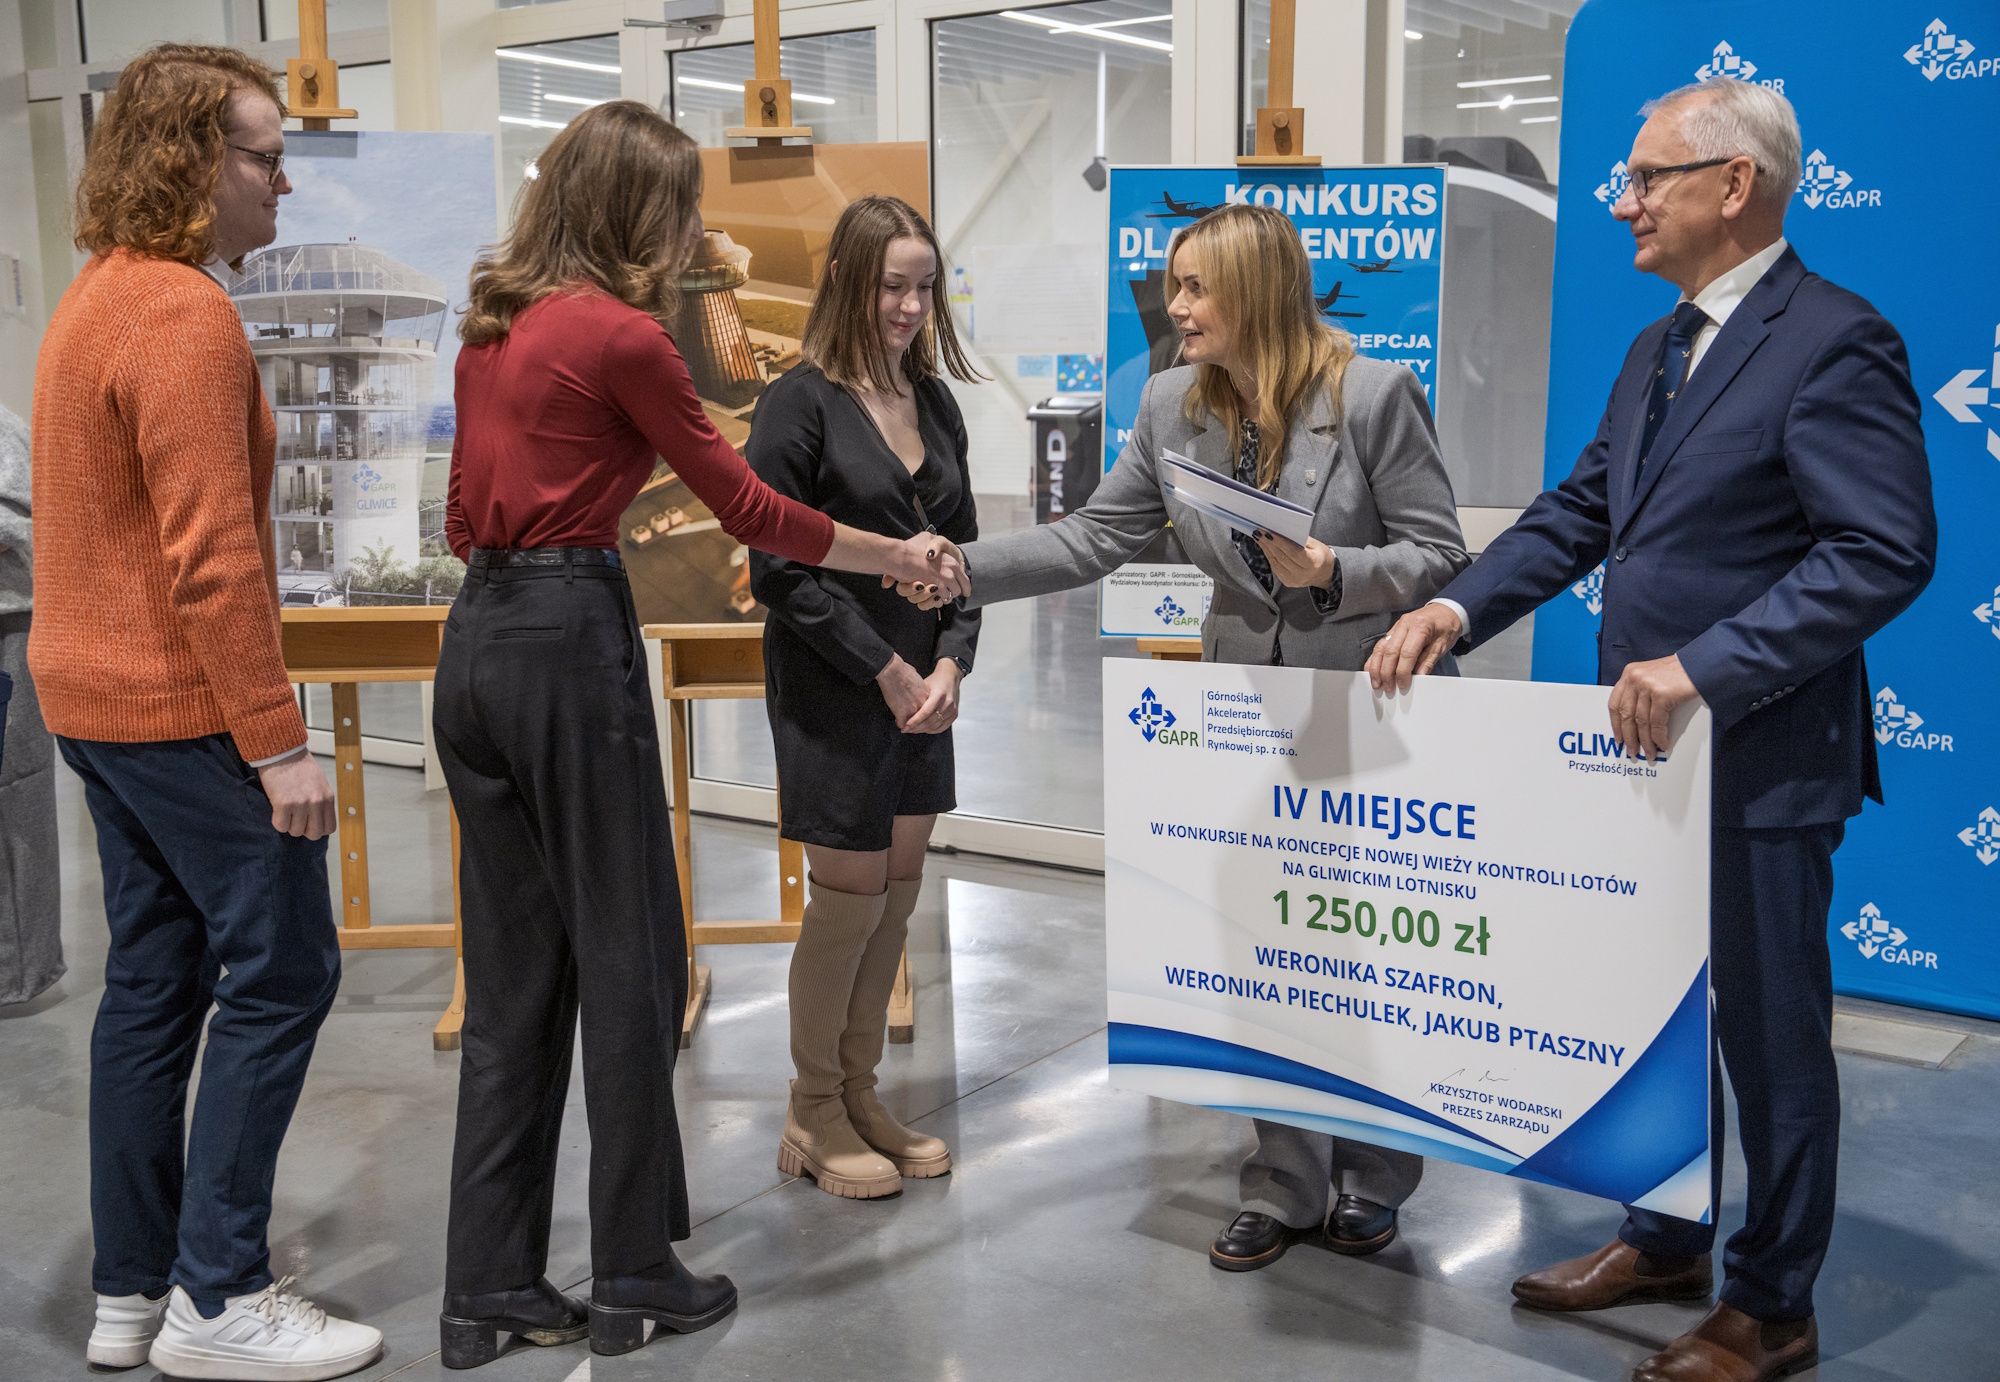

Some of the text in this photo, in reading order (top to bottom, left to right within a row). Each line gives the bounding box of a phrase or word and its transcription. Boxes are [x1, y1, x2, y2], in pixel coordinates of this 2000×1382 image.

[1224, 183, 1437, 216] KONKURS
[1826, 190, 1882, 209] GAPR
[1300, 220, 1436, 260] ENTÓW
[1046, 428, 1067, 513] PAND
[370, 482, 397, 491] GAPR
[356, 497, 397, 510] GLIWICE
[1141, 579, 1173, 587] koordynator
[1173, 617, 1200, 626] GAPR
[1206, 690, 1263, 705] Górnośląski
[1206, 707, 1262, 720] Akcelerator
[1157, 729, 1200, 748] GAPR
[1206, 723, 1294, 740] Przedsiębiorczości
[1896, 730, 1954, 752] GAPR
[1206, 739, 1298, 757] Rynkowej sp. z o.o.
[1558, 731, 1668, 762] GLIW
[1568, 760, 1658, 778] Przyszłość jest tu
[1274, 784, 1476, 840] IV MIEJSCE
[1150, 822, 1638, 897] W KONKURSIE NA KONCEPCJE NOWEJ WIEŻY KONTROLI LOTÓW
[1283, 861, 1477, 901] NA GLIWICKIM LOTNISKU
[1273, 890, 1491, 956] 1 250,00 zł
[1881, 946, 1938, 969] GAPR
[1255, 945, 1503, 1010] WERONIKA SZAFRON,
[1165, 965, 1626, 1067] WERONIKA PIECHULEK, JAKUB PTASZNY
[1430, 1082, 1562, 1120] KRZYSZTOF WODARSKI
[1442, 1102, 1550, 1134] PREZES ZARRZĄDU
